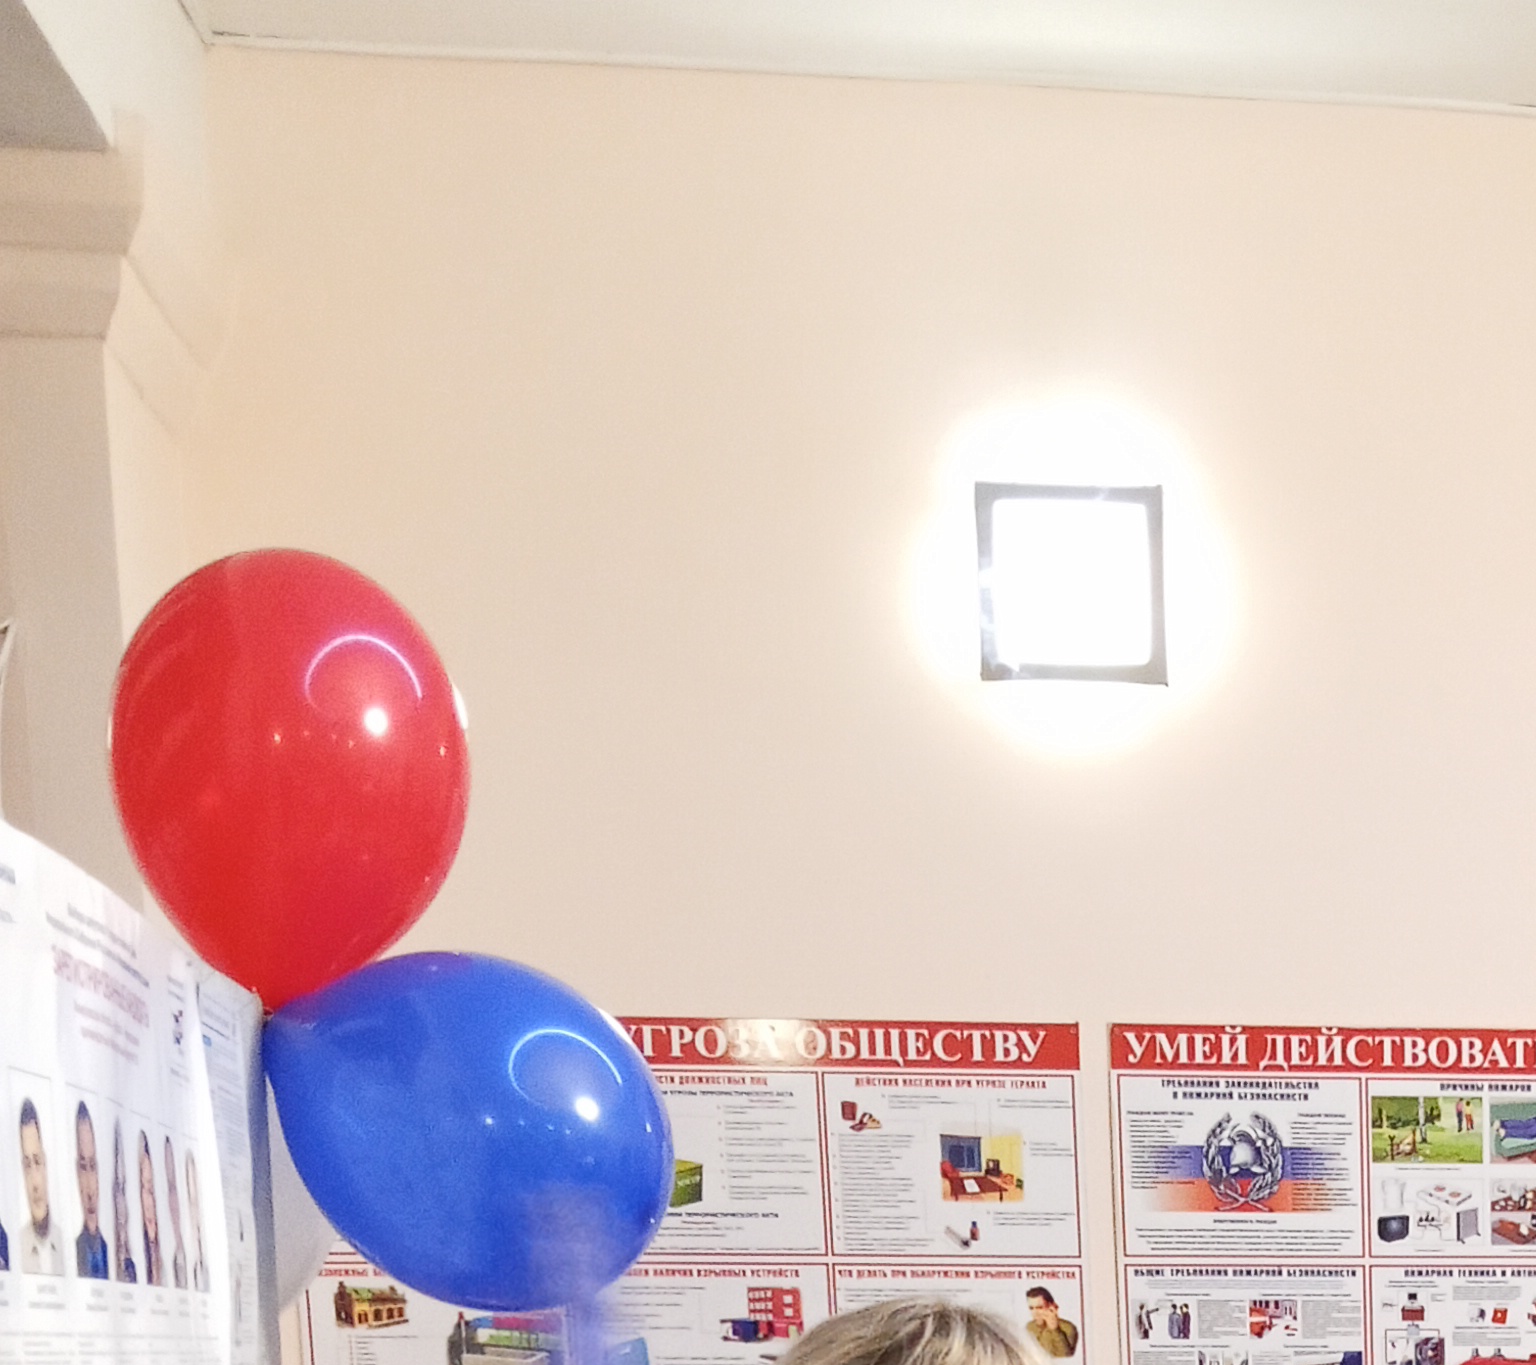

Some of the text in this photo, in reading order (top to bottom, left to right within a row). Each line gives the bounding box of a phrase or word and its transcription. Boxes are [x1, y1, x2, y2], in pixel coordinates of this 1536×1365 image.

[794, 1024, 1048, 1068] ОБЩЕСТВУ
[1124, 1026, 1251, 1066] УМЕЙ
[1161, 1079, 1319, 1090] ТРЕБОВАНИЯ ЗАКОНОДАТЕЛЬСТВА
[1440, 1083, 1532, 1092] ПРИЧИНЫ ПОЖАРОВ
[1182, 1091, 1234, 1100] ПОЖАРНОЙ
[1238, 1092, 1309, 1101] БЕЗОПАСНОСТИ
[1134, 1267, 1357, 1278] ОБЩИЕ ТРЕБОВАНИЯ ПОЖАРНОЙ БЕЗОПАСНОСТИ
[1404, 1269, 1454, 1278] ПОЖАРНАЯ
[1458, 1269, 1497, 1278] ТЕХНИКА
